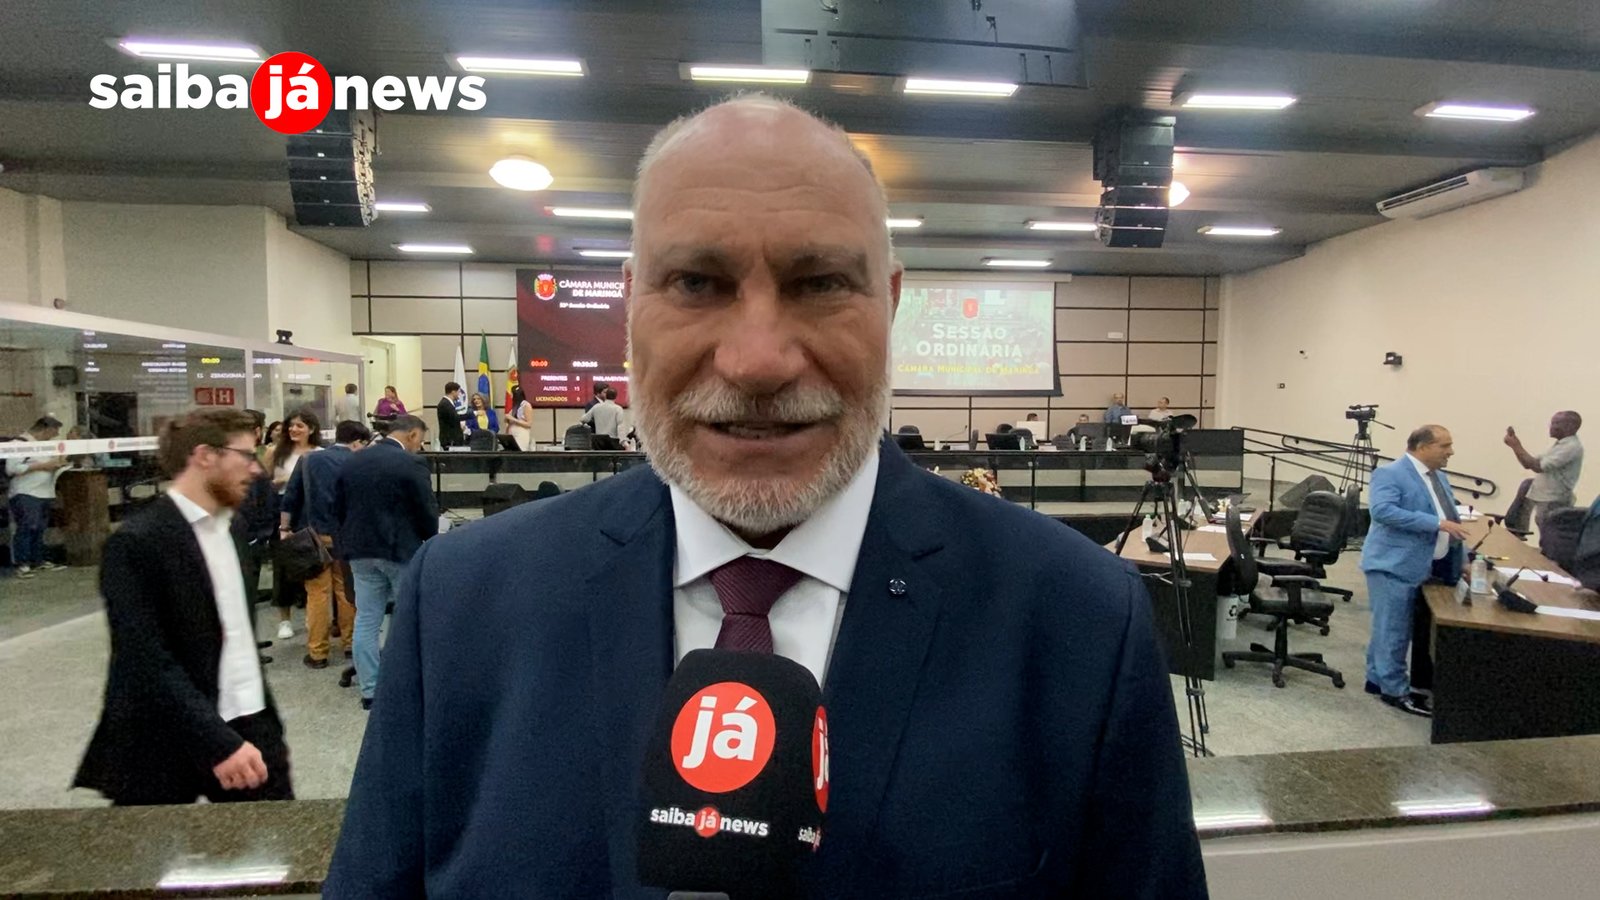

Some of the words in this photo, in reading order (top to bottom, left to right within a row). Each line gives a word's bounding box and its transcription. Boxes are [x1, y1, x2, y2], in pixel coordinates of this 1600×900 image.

[559, 280, 592, 289] CÂMARA
[585, 290, 623, 298] MARINGÁ
[682, 696, 758, 769] já
[650, 807, 696, 826] saiba
[698, 811, 717, 830] já
[719, 815, 769, 837] news
